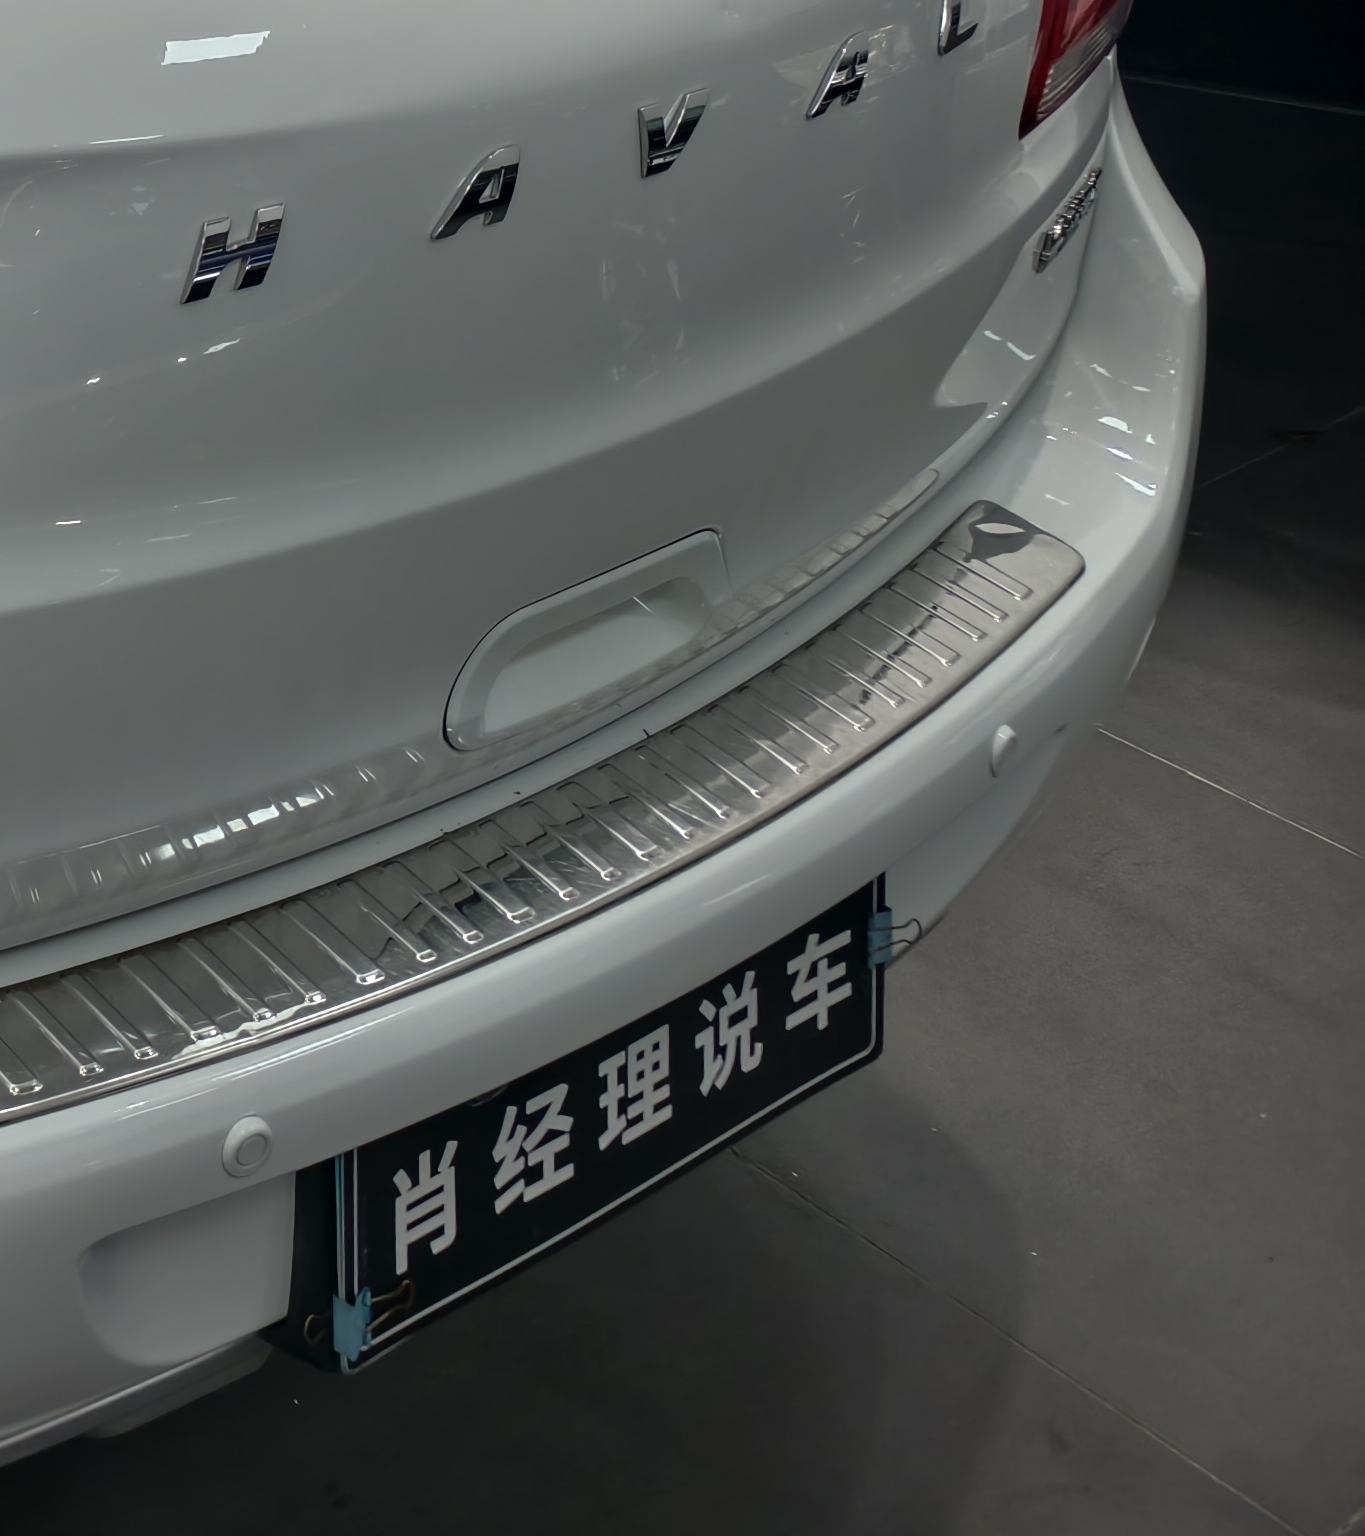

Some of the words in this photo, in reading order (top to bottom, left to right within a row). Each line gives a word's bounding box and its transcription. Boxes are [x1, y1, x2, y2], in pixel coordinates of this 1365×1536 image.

[392, 928, 854, 1276] 肖经理说车
